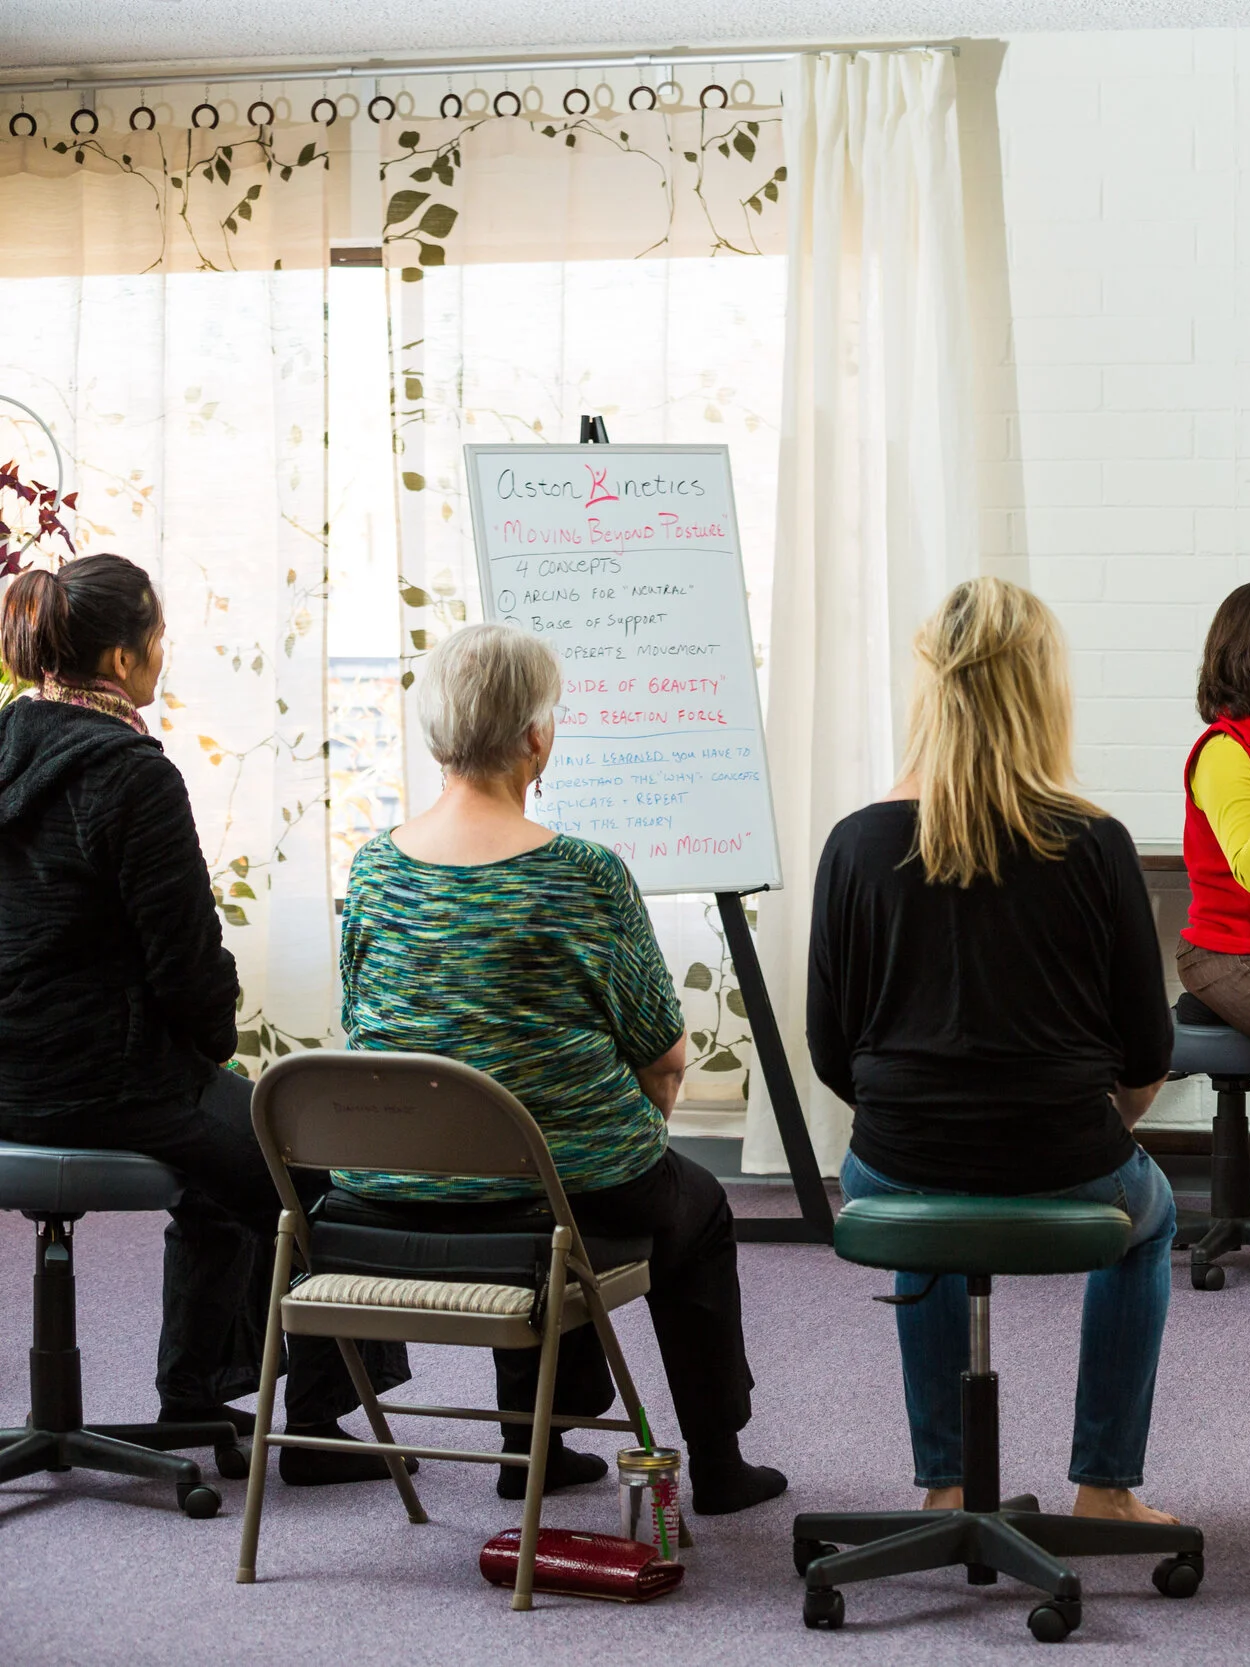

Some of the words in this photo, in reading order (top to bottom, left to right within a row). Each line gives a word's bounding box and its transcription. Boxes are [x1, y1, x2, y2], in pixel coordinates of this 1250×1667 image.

[516, 560, 528, 577] 4
[523, 588, 580, 604] ARCING
[592, 587, 616, 600] FOR
[532, 616, 573, 632] Base
[618, 678, 637, 693] OF
[600, 710, 668, 725] REACTION
[678, 709, 728, 724] FORCE
[554, 753, 596, 767] HAVE
[602, 751, 665, 765] LEARNED
[702, 748, 732, 759] HAVE
[736, 747, 751, 757] TO
[541, 777, 623, 790] NDERSTAND
[631, 774, 657, 785] THE
[711, 771, 760, 781] CONCEPTS
[636, 791, 689, 806] REPEAT
[590, 819, 619, 832] THE
[626, 815, 672, 830] THEORY
[650, 841, 668, 858] IN
